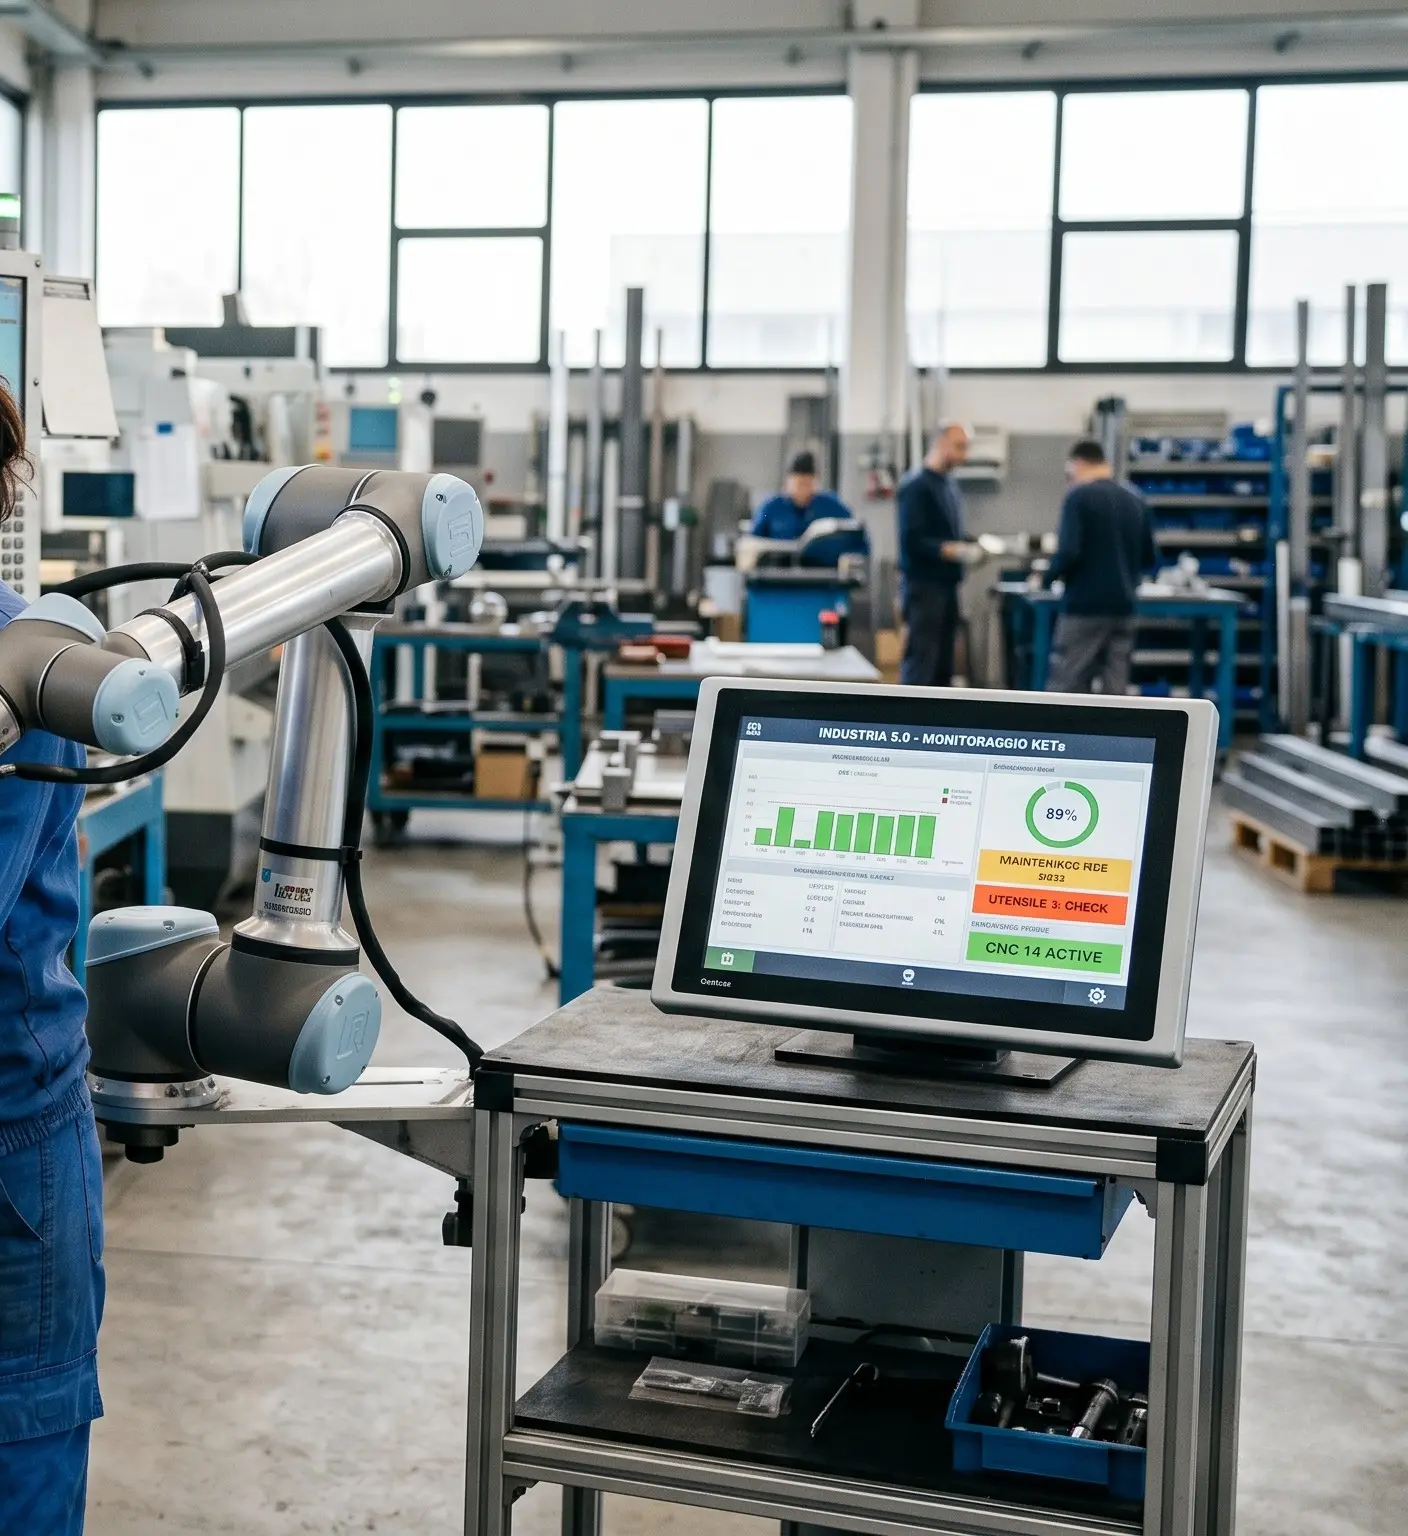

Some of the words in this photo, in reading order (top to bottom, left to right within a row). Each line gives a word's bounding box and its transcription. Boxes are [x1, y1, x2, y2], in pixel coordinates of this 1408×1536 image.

[818, 727, 887, 742] INDUSTRIA
[890, 732, 911, 743] 5.0
[922, 733, 1028, 750] MONITORAGGIO
[1030, 739, 1066, 752] KETs
[1046, 807, 1078, 822] 89%
[988, 894, 1047, 909] UTENSILE
[1051, 900, 1061, 910] 3:
[1064, 901, 1109, 914] CHECK
[985, 941, 1020, 956] CNC
[1024, 945, 1041, 958] 14
[1044, 947, 1103, 964] ACTIVE
